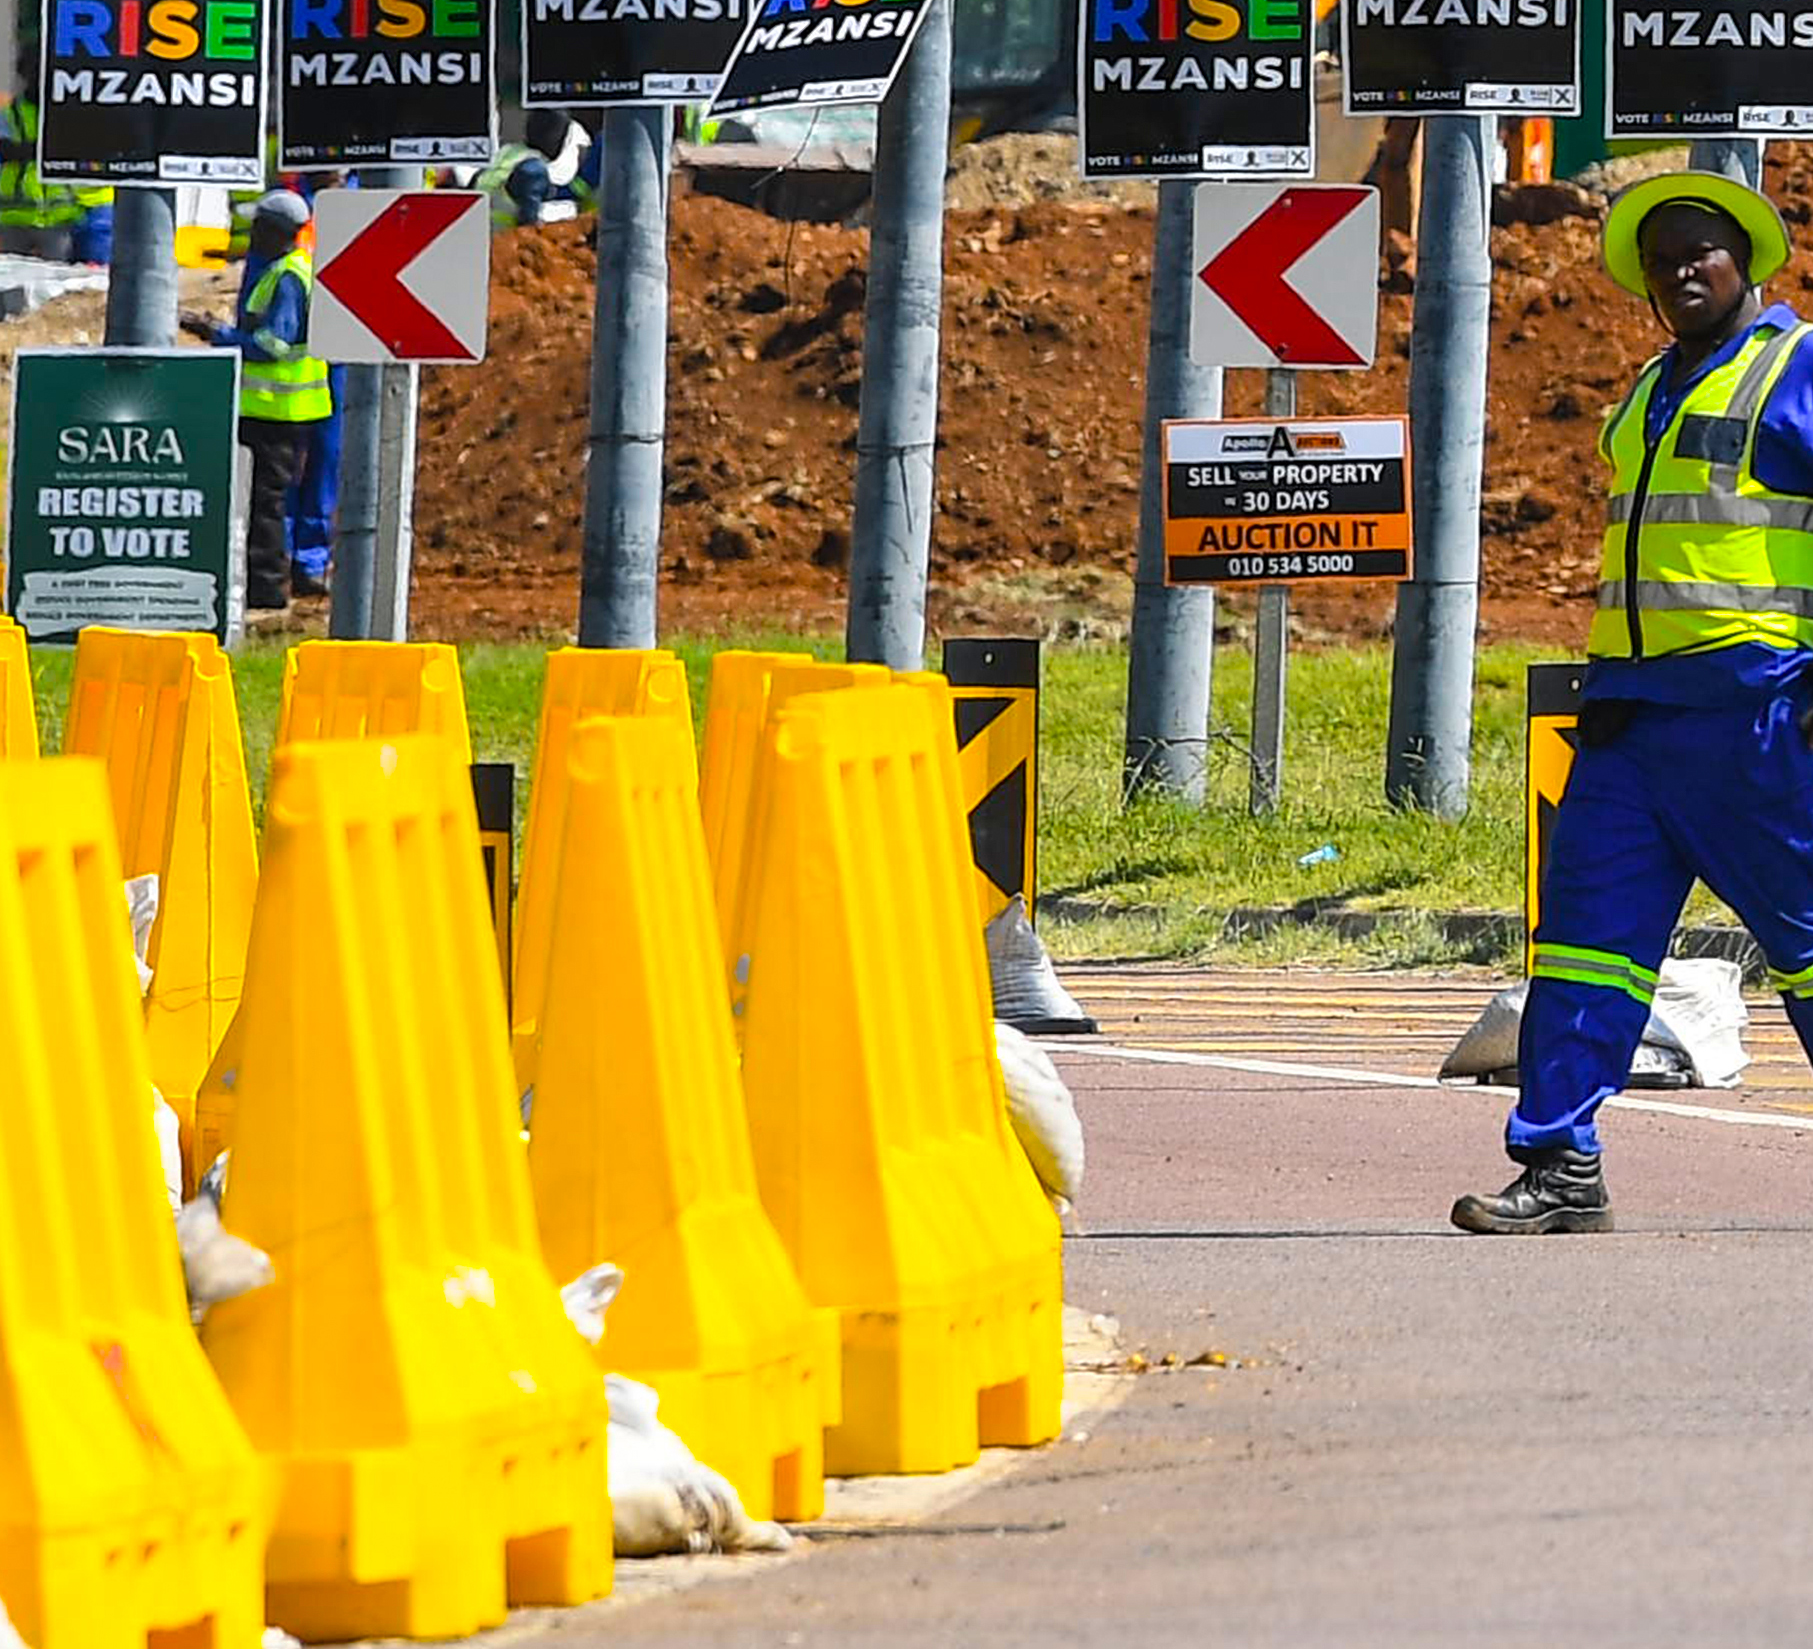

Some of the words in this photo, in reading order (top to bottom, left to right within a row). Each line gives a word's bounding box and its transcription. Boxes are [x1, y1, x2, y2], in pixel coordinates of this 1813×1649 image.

[55, 0, 256, 60] RISE
[749, 10, 915, 52] MZANSI
[51, 71, 255, 106] MZANSI
[1615, 112, 1650, 125] VOTE
[1681, 112, 1734, 125] MZANSI
[1742, 110, 1771, 126] RISE
[58, 426, 184, 463] SARA
[1188, 467, 1235, 486] SELL
[1273, 464, 1384, 485] PROPERTY
[38, 488, 204, 518] REGISTER
[1243, 492, 1269, 512] 30
[1276, 491, 1329, 510] DAYS
[50, 527, 95, 557] TO
[102, 528, 191, 557] VOTE
[1199, 522, 1340, 552] AUCTION
[1352, 521, 1378, 547] IT
[1229, 558, 1263, 576] 010
[1269, 557, 1302, 574] 534
[1307, 555, 1353, 573] 5000
